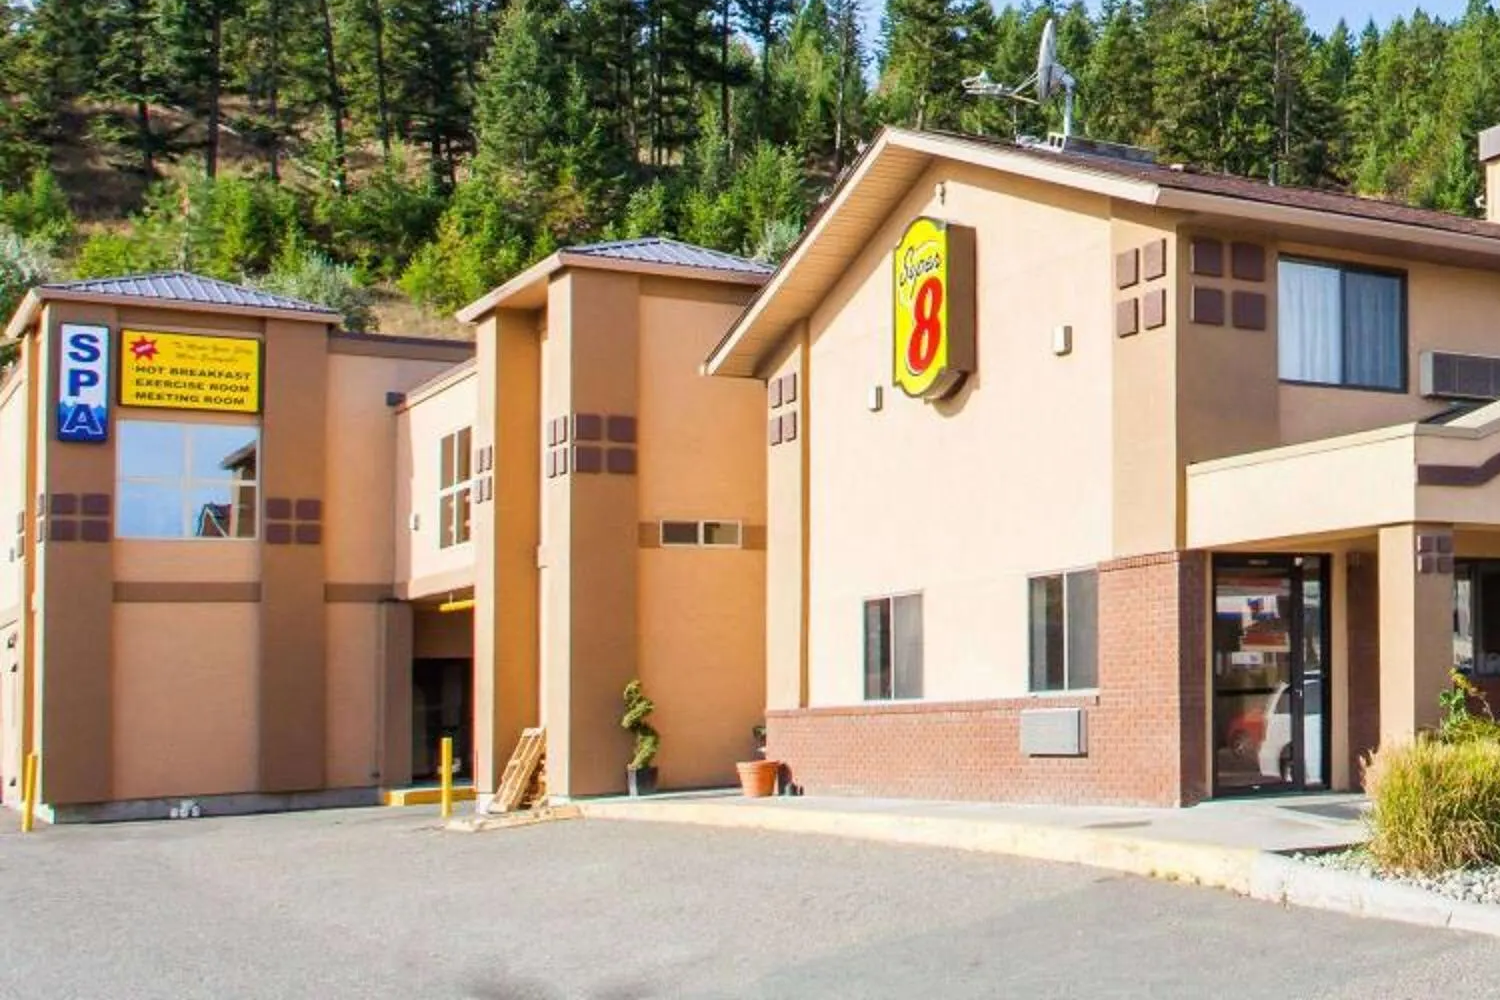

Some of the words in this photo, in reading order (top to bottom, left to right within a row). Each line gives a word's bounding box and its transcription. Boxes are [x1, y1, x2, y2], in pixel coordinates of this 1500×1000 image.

[899, 246, 941, 298] Super
[907, 276, 944, 374] 8
[61, 333, 103, 434] SPA
[135, 365, 164, 375] HOT
[169, 366, 251, 380] BREAKFAST
[135, 378, 205, 390] EXERCISE
[209, 382, 250, 393] ROOM
[135, 391, 199, 403] MEETING
[203, 394, 245, 406] ROOM
